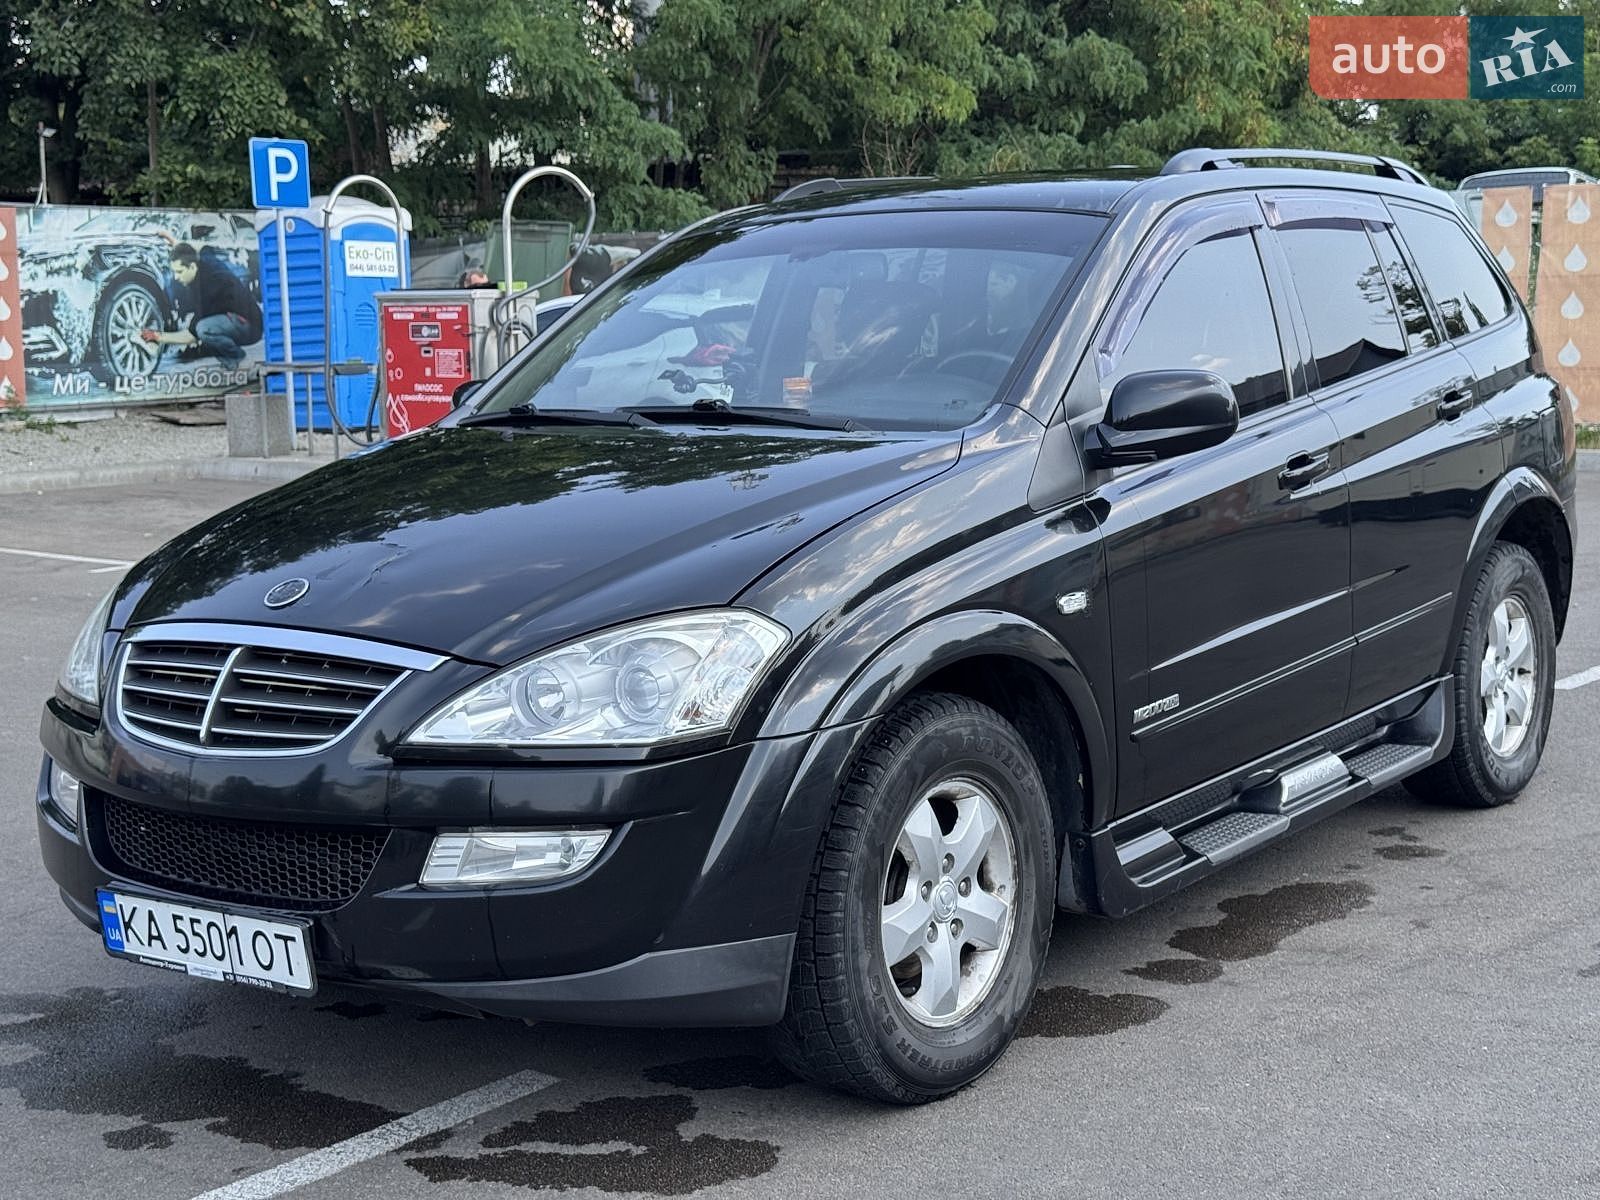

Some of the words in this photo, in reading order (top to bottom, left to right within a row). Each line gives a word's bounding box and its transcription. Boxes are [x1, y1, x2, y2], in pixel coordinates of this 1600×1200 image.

[268, 147, 299, 202] P
[53, 373, 89, 396] Ми
[115, 374, 145, 394] це
[152, 367, 249, 394] турбота
[107, 926, 122, 942] UA
[171, 913, 244, 966] 5501
